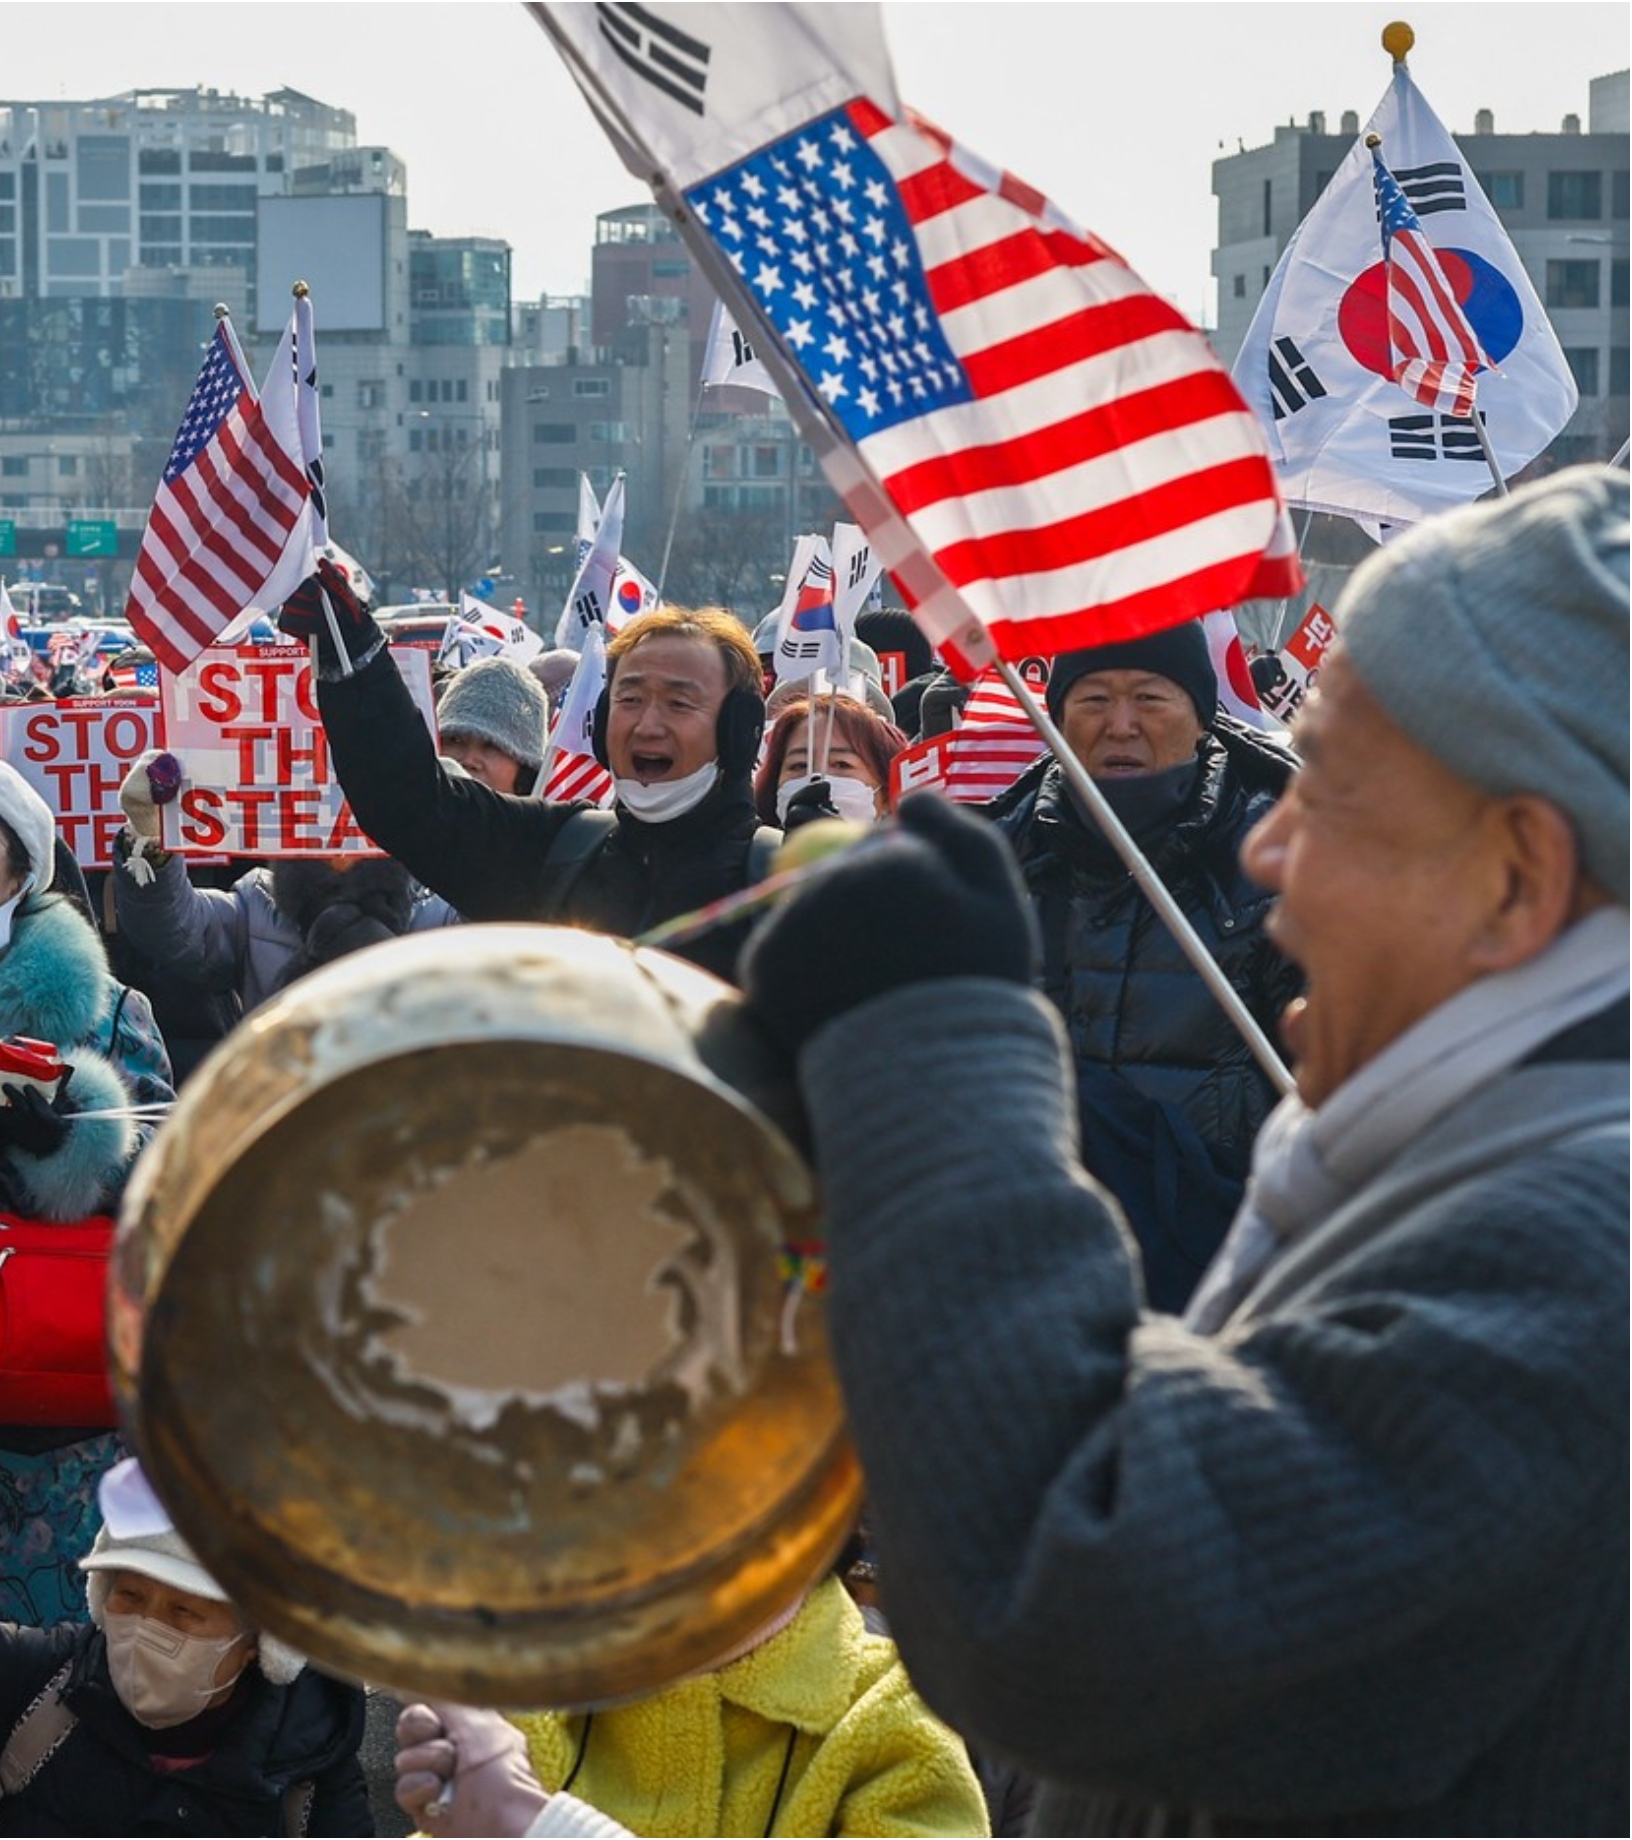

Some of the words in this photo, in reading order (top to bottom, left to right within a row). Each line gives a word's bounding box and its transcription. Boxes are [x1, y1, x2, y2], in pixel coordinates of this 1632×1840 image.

[221, 726, 329, 785] TH
[44, 763, 131, 812] TH
[181, 788, 380, 849] STEA
